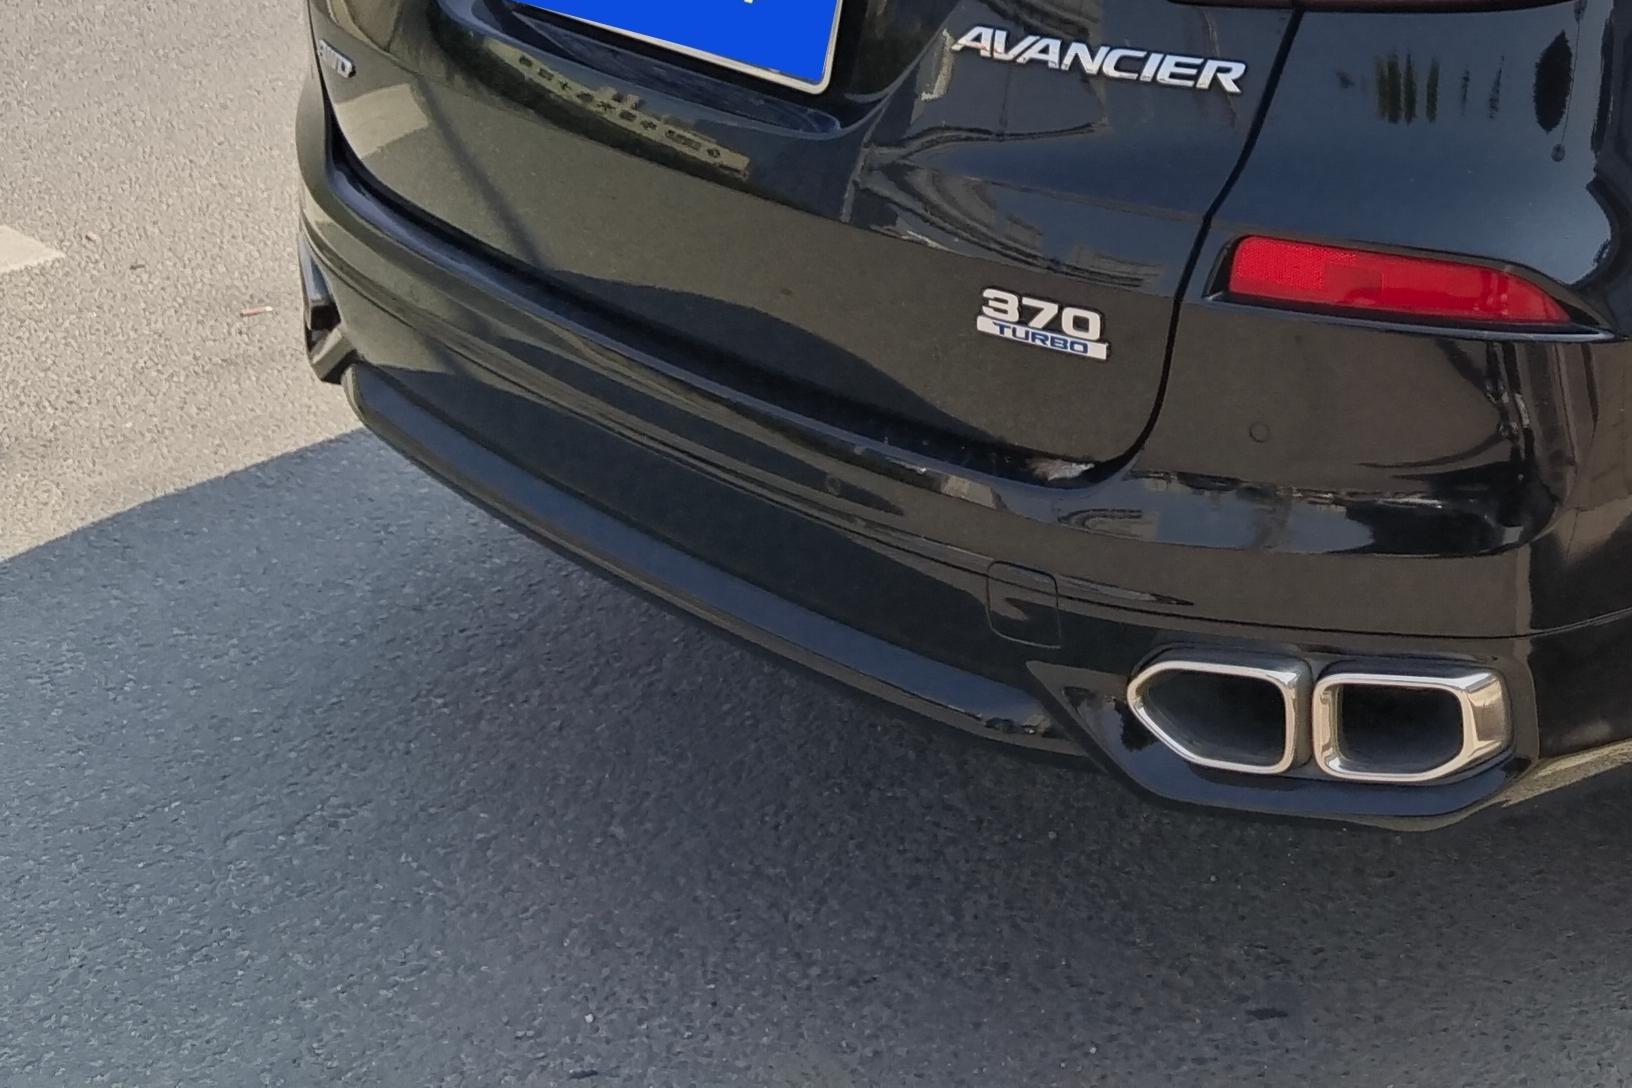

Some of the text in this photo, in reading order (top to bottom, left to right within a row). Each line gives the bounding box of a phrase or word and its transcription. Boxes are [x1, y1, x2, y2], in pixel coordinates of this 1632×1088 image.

[951, 25, 1247, 94] AVANCIER
[981, 288, 1101, 341] 370
[992, 321, 1089, 354] TURBO
